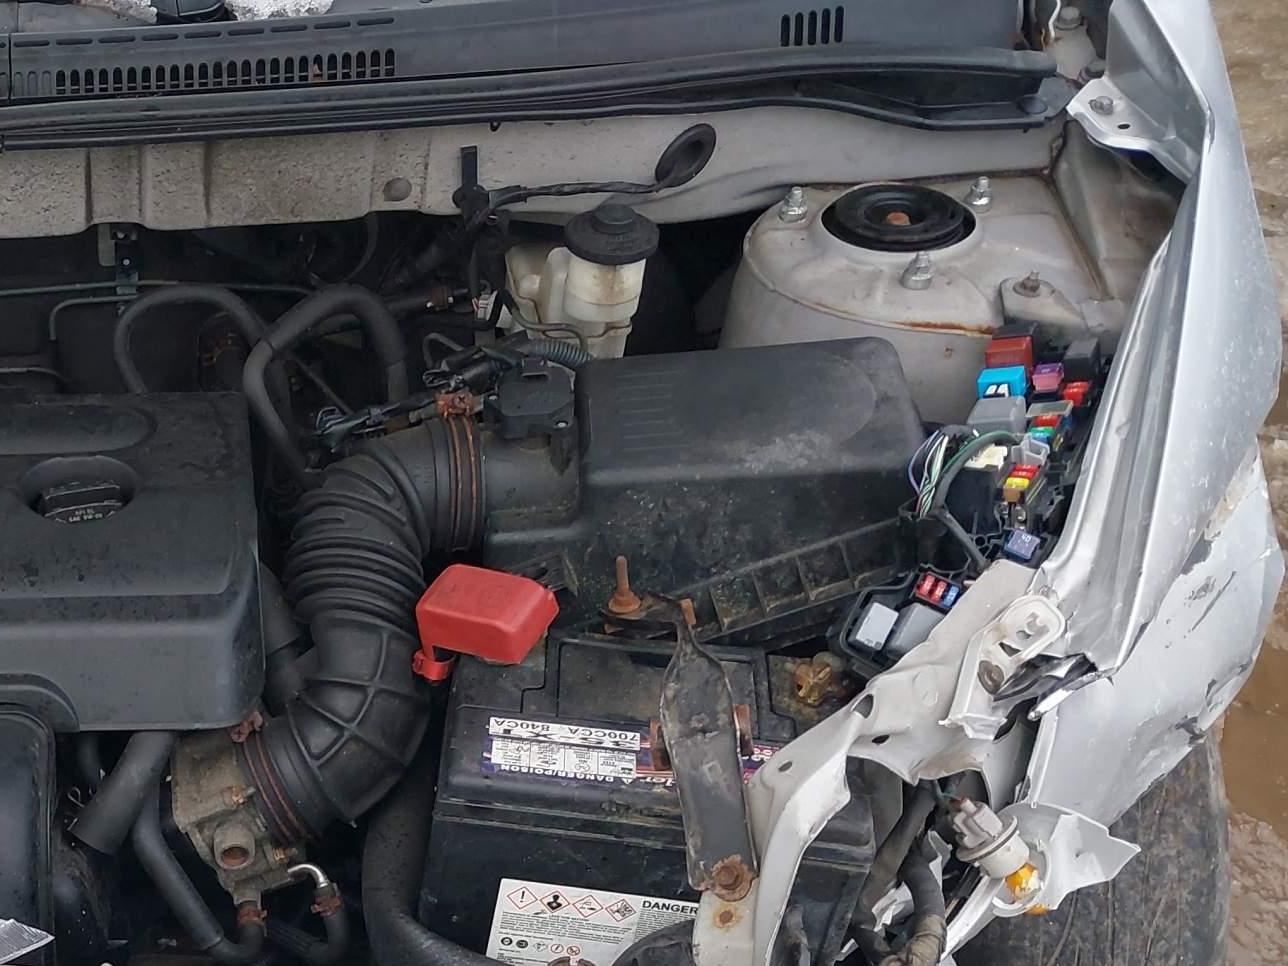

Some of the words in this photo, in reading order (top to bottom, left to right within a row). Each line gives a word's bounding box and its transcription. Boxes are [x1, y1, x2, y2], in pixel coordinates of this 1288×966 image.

[493, 718, 550, 732] 840CA
[501, 763, 615, 783] DANGER/POISON
[642, 900, 698, 914] DANGER
